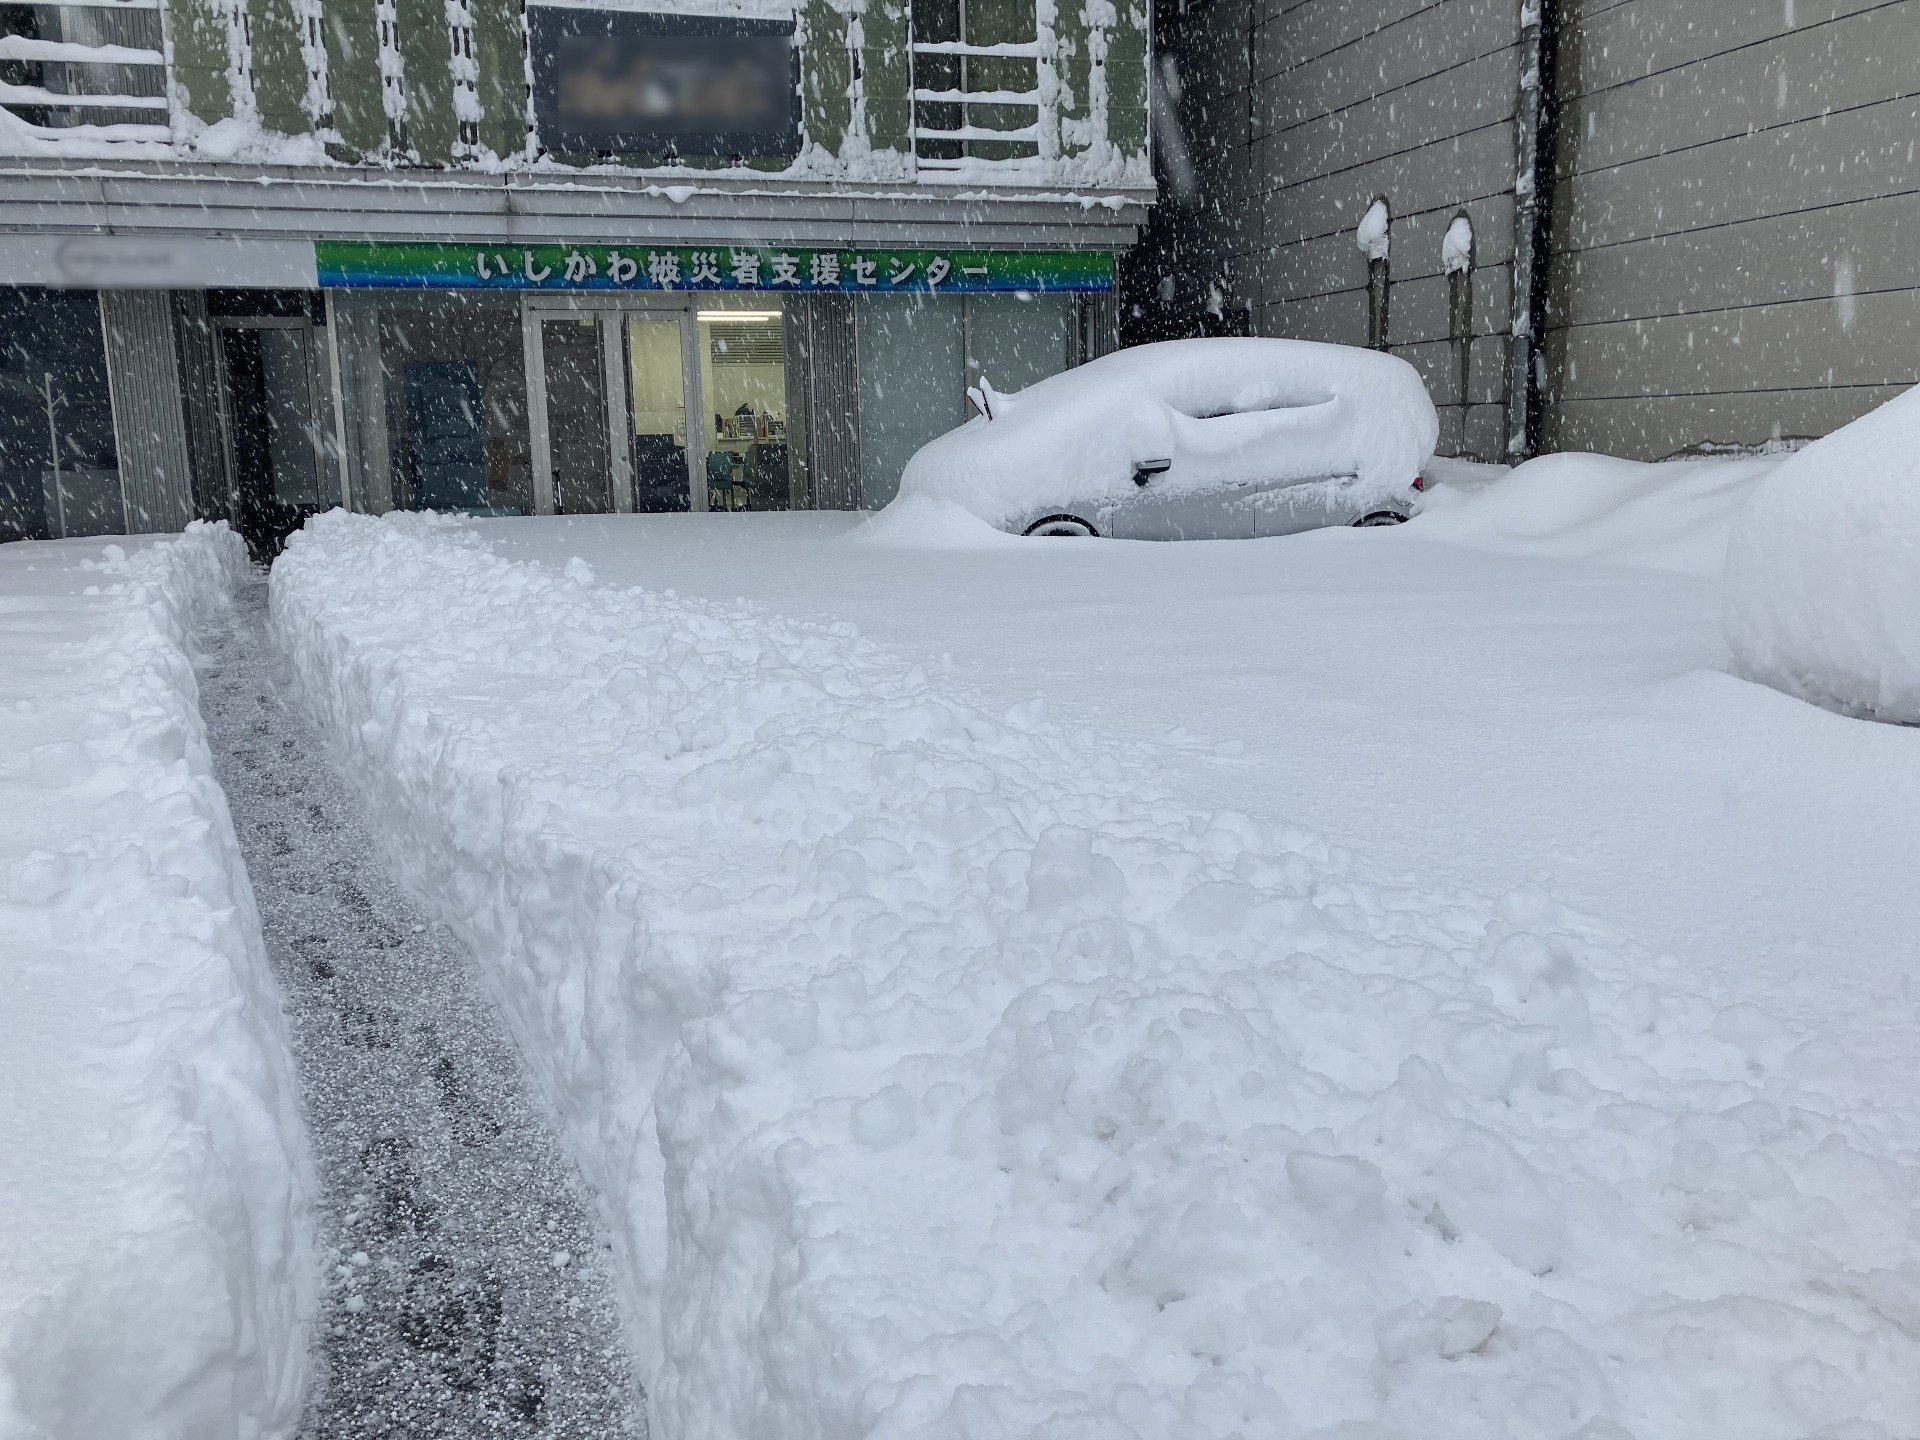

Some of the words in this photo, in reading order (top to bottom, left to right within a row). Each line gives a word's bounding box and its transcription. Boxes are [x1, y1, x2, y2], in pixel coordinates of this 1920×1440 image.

[477, 251, 988, 285] いしかわ被災者支援センター
